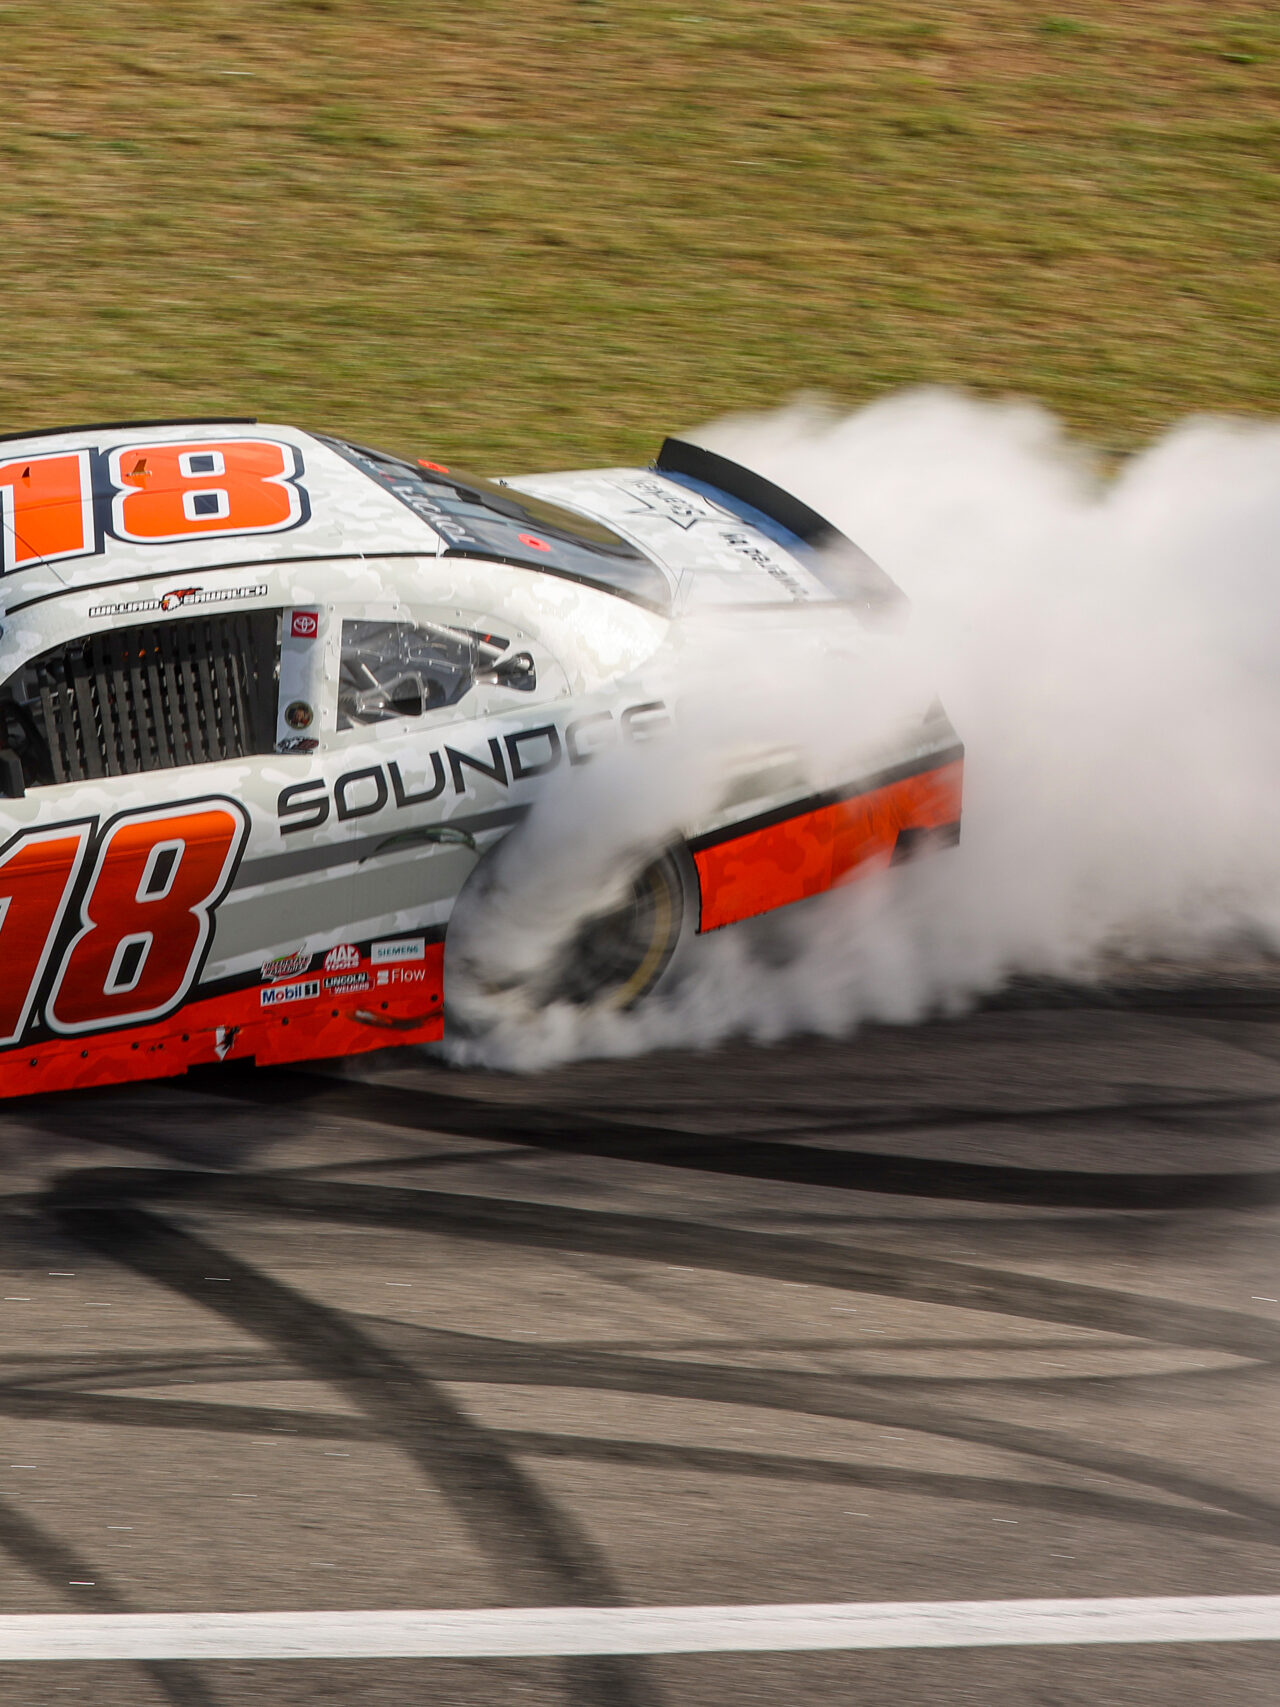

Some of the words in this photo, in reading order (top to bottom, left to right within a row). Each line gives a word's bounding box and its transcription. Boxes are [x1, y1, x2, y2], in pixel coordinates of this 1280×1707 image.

[89, 600, 161, 618] WILLIAM
[277, 699, 670, 836] SOUNDGE
[325, 945, 359, 963] MAC
[377, 946, 419, 957] SIEMENS
[325, 972, 366, 988] LINCOLN
[392, 969, 426, 984] Flow
[262, 984, 302, 1004] Mobil
